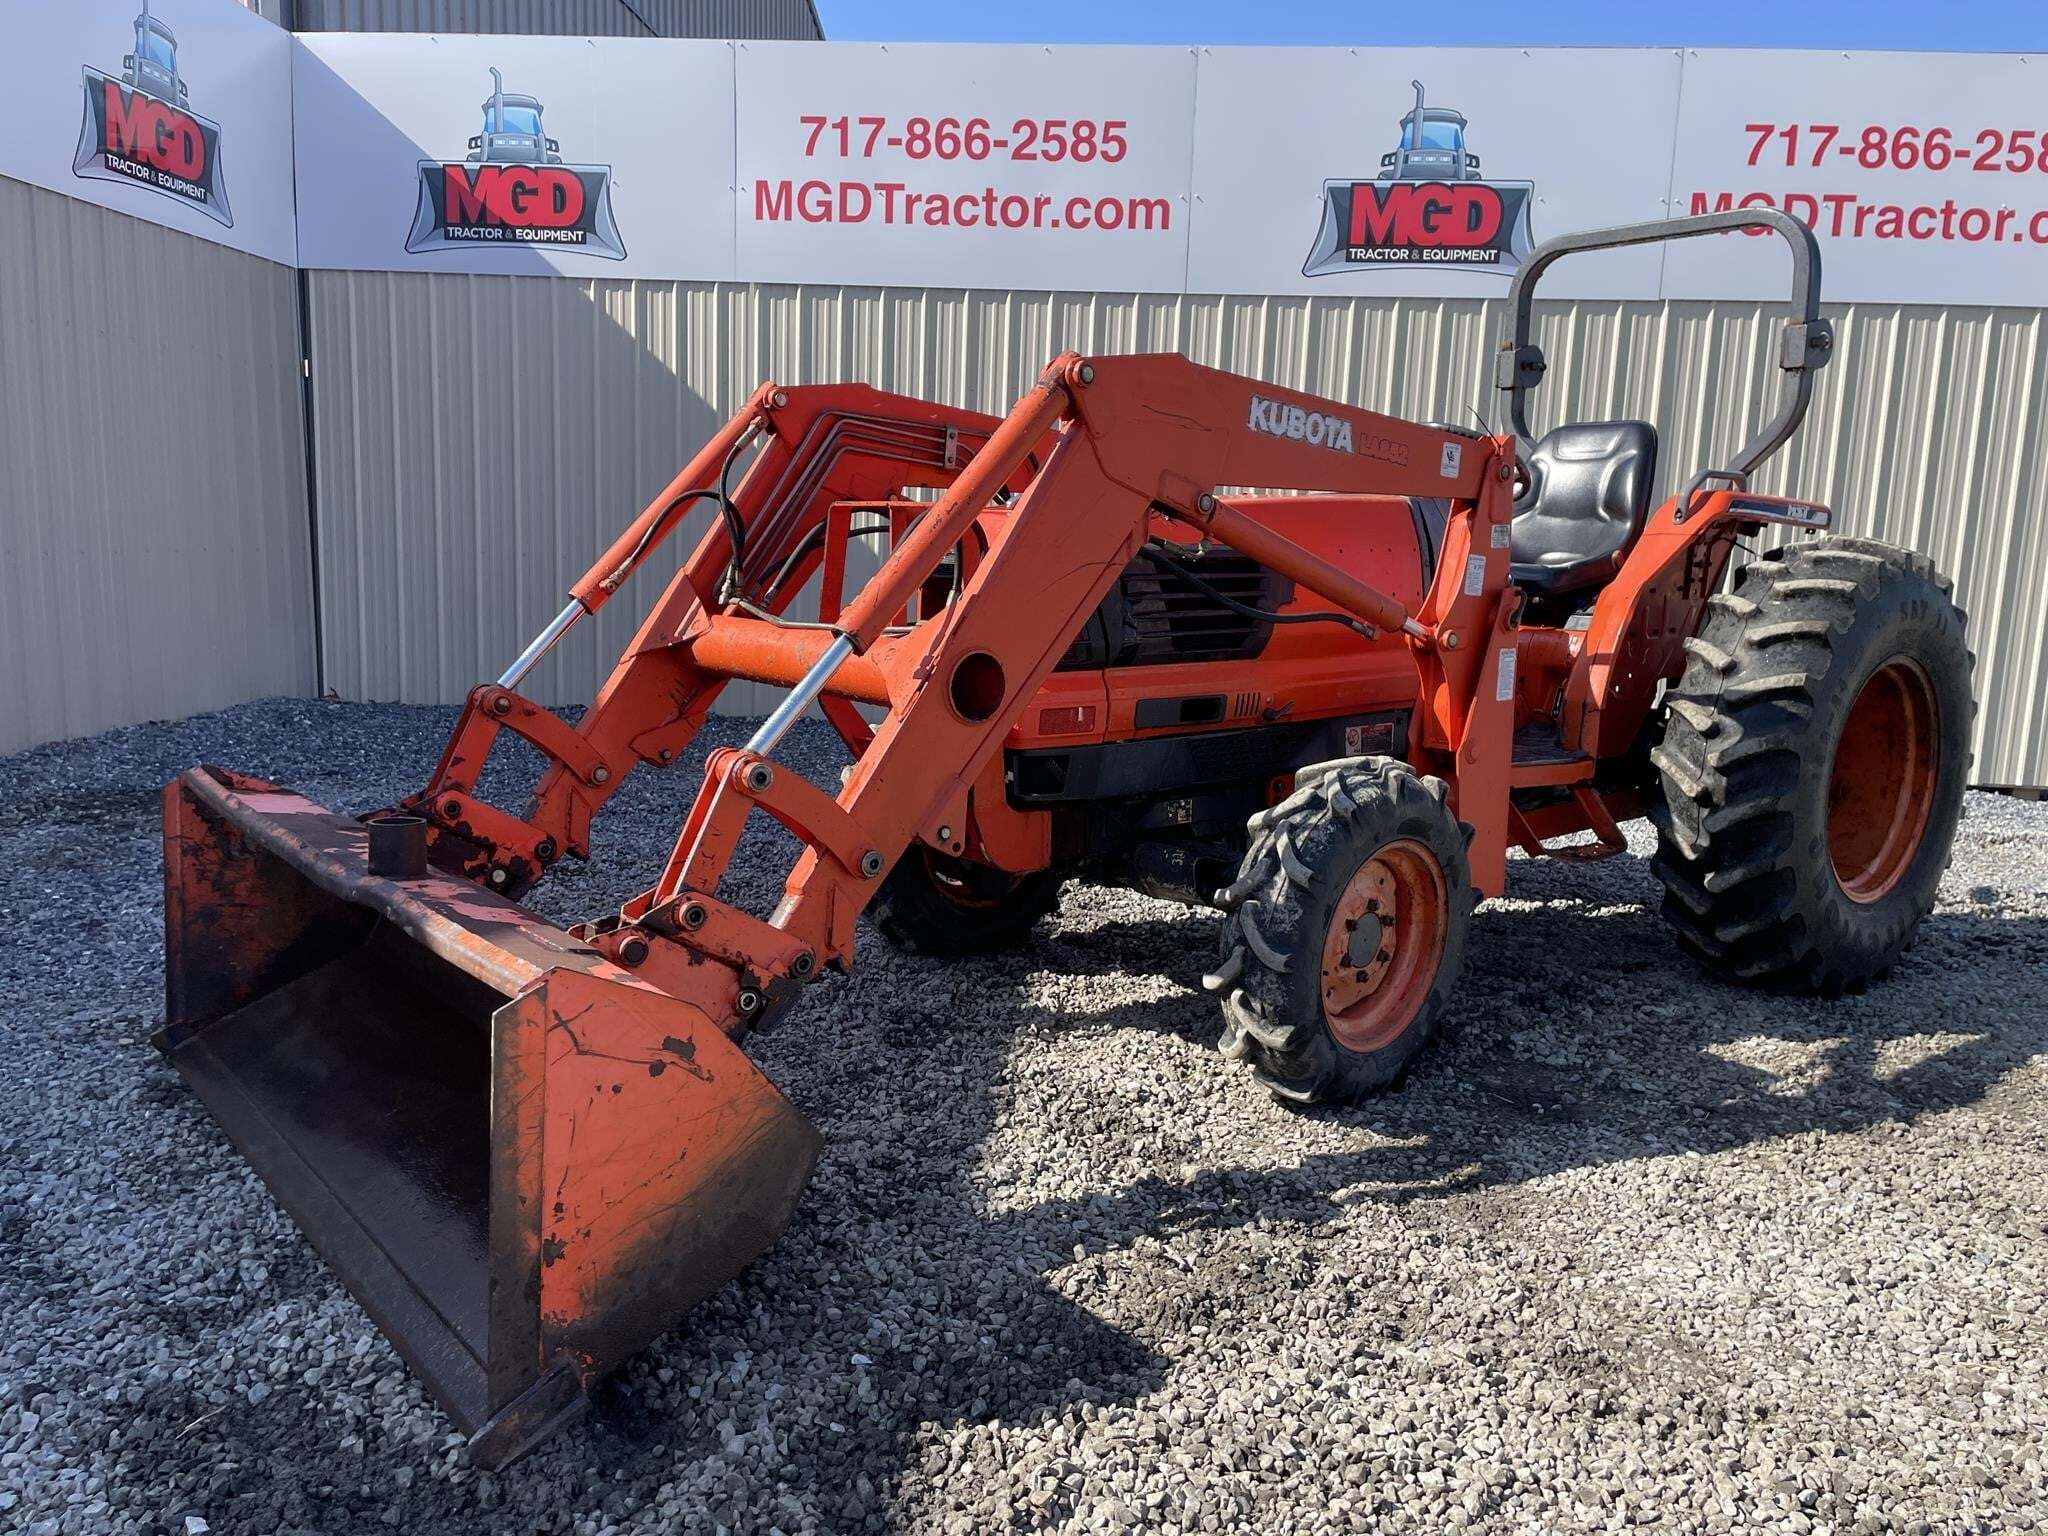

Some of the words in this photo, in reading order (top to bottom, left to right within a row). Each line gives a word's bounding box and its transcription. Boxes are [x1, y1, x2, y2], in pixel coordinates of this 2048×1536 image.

[104, 79, 205, 181] MGD
[800, 116, 1127, 162] 717-866-2585
[106, 154, 149, 179] TRACTOR
[151, 169, 157, 181] &
[158, 174, 206, 199] EQUIPMENT
[444, 165, 584, 226] MGD
[755, 180, 1170, 230] MGDTractor.com
[1350, 183, 1502, 247] MGD
[447, 227, 502, 239] TRACTOR
[505, 228, 513, 239] &
[515, 229, 584, 242] EQUIPMENT
[1350, 249, 1409, 260] TRACTOR
[1411, 249, 1420, 260] &
[1423, 250, 1498, 261] EQUIPMENT
[1248, 394, 1354, 453] KUBOTA
